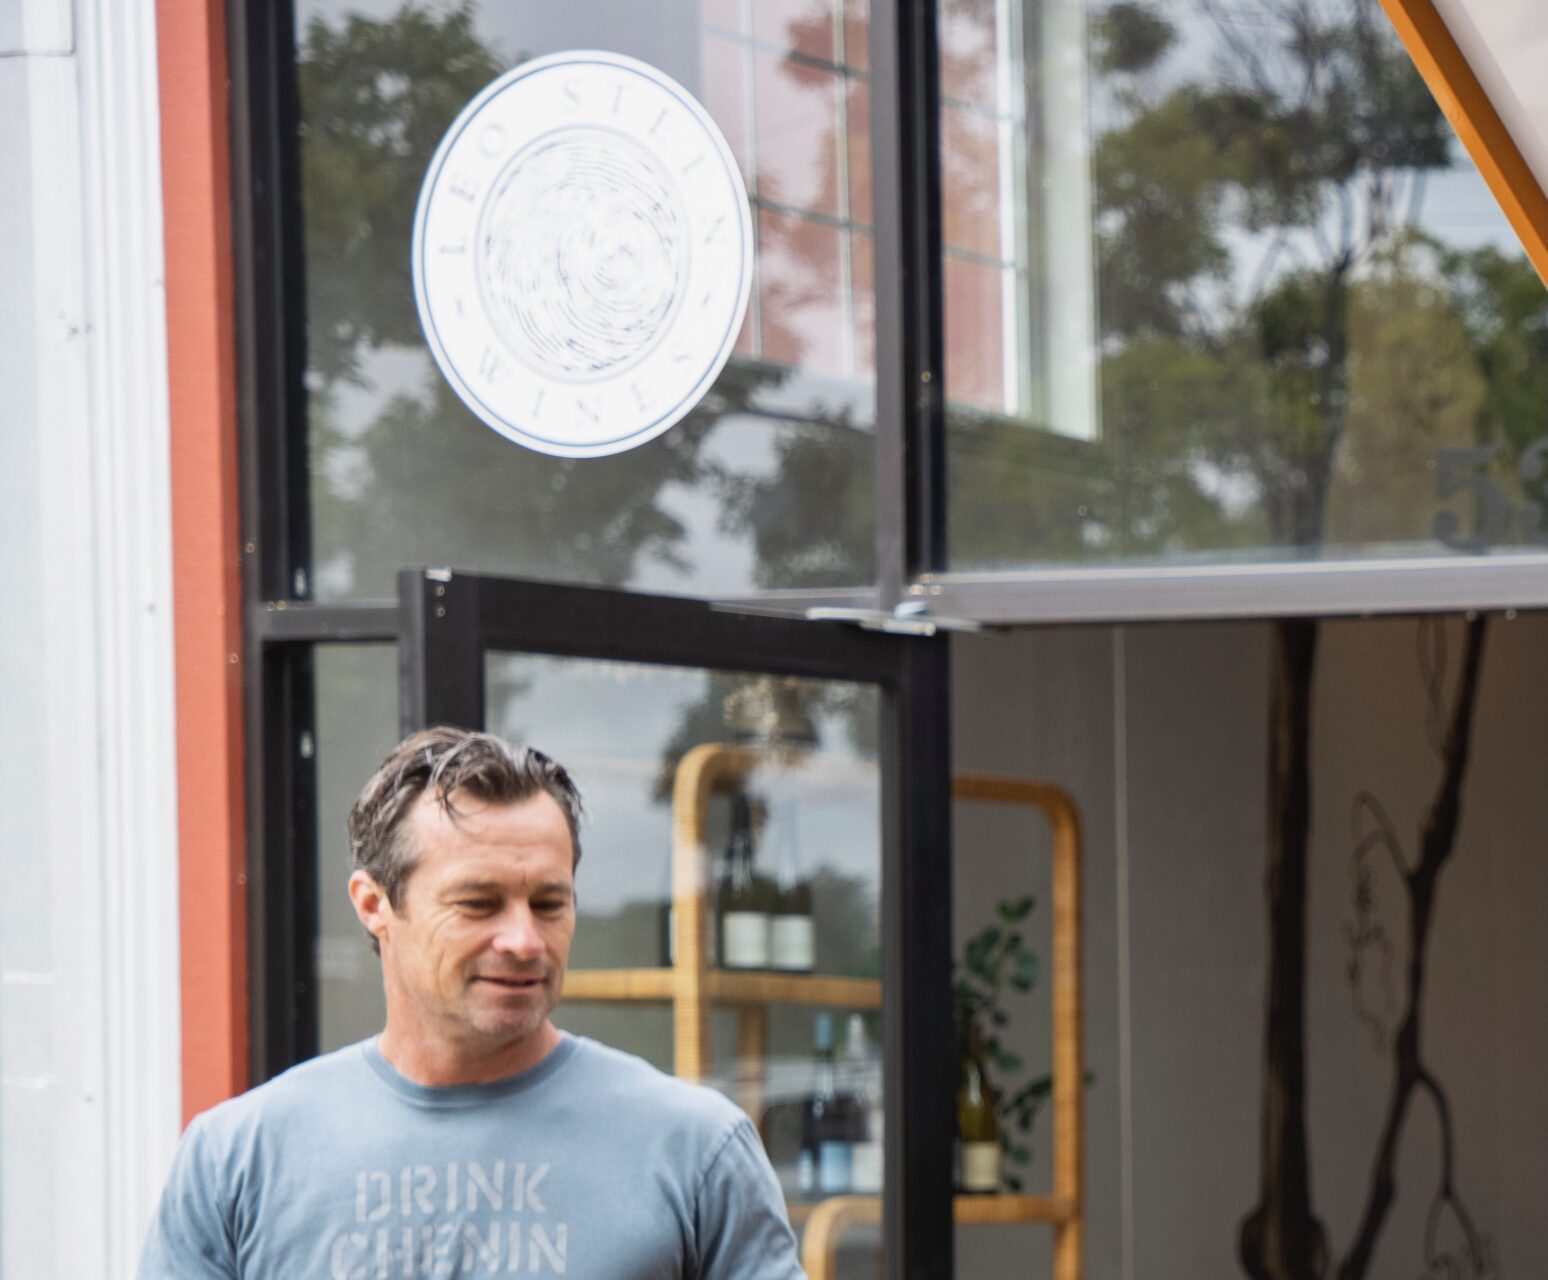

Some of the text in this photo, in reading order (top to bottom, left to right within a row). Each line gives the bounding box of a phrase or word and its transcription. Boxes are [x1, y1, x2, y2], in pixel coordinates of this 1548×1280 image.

[439, 79, 730, 255] LEO STEEN
[478, 344, 693, 428] WINES
[355, 1159, 551, 1223] DRINK
